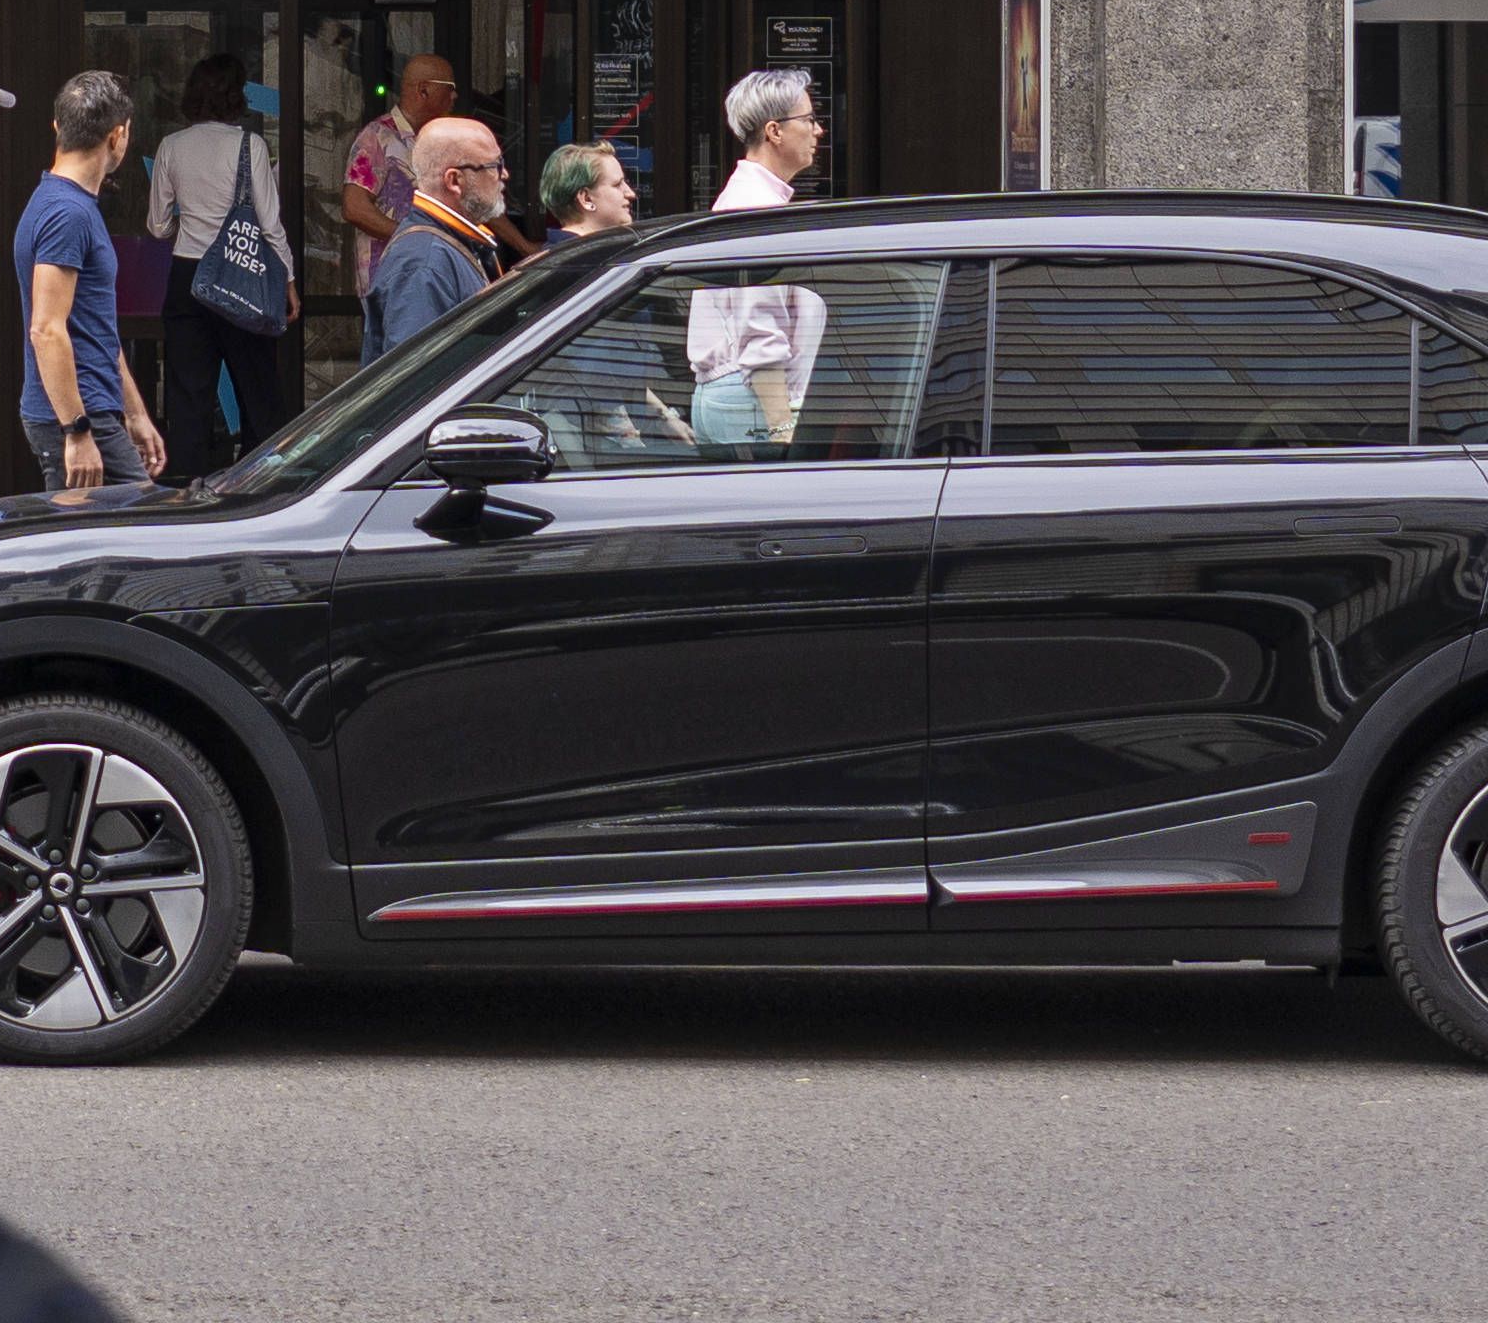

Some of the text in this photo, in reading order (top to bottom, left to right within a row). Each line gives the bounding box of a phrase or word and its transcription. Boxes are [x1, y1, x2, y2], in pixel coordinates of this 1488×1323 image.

[228, 219, 261, 240] ARE
[227, 232, 259, 256] YOU
[224, 246, 267, 276] WISE?
